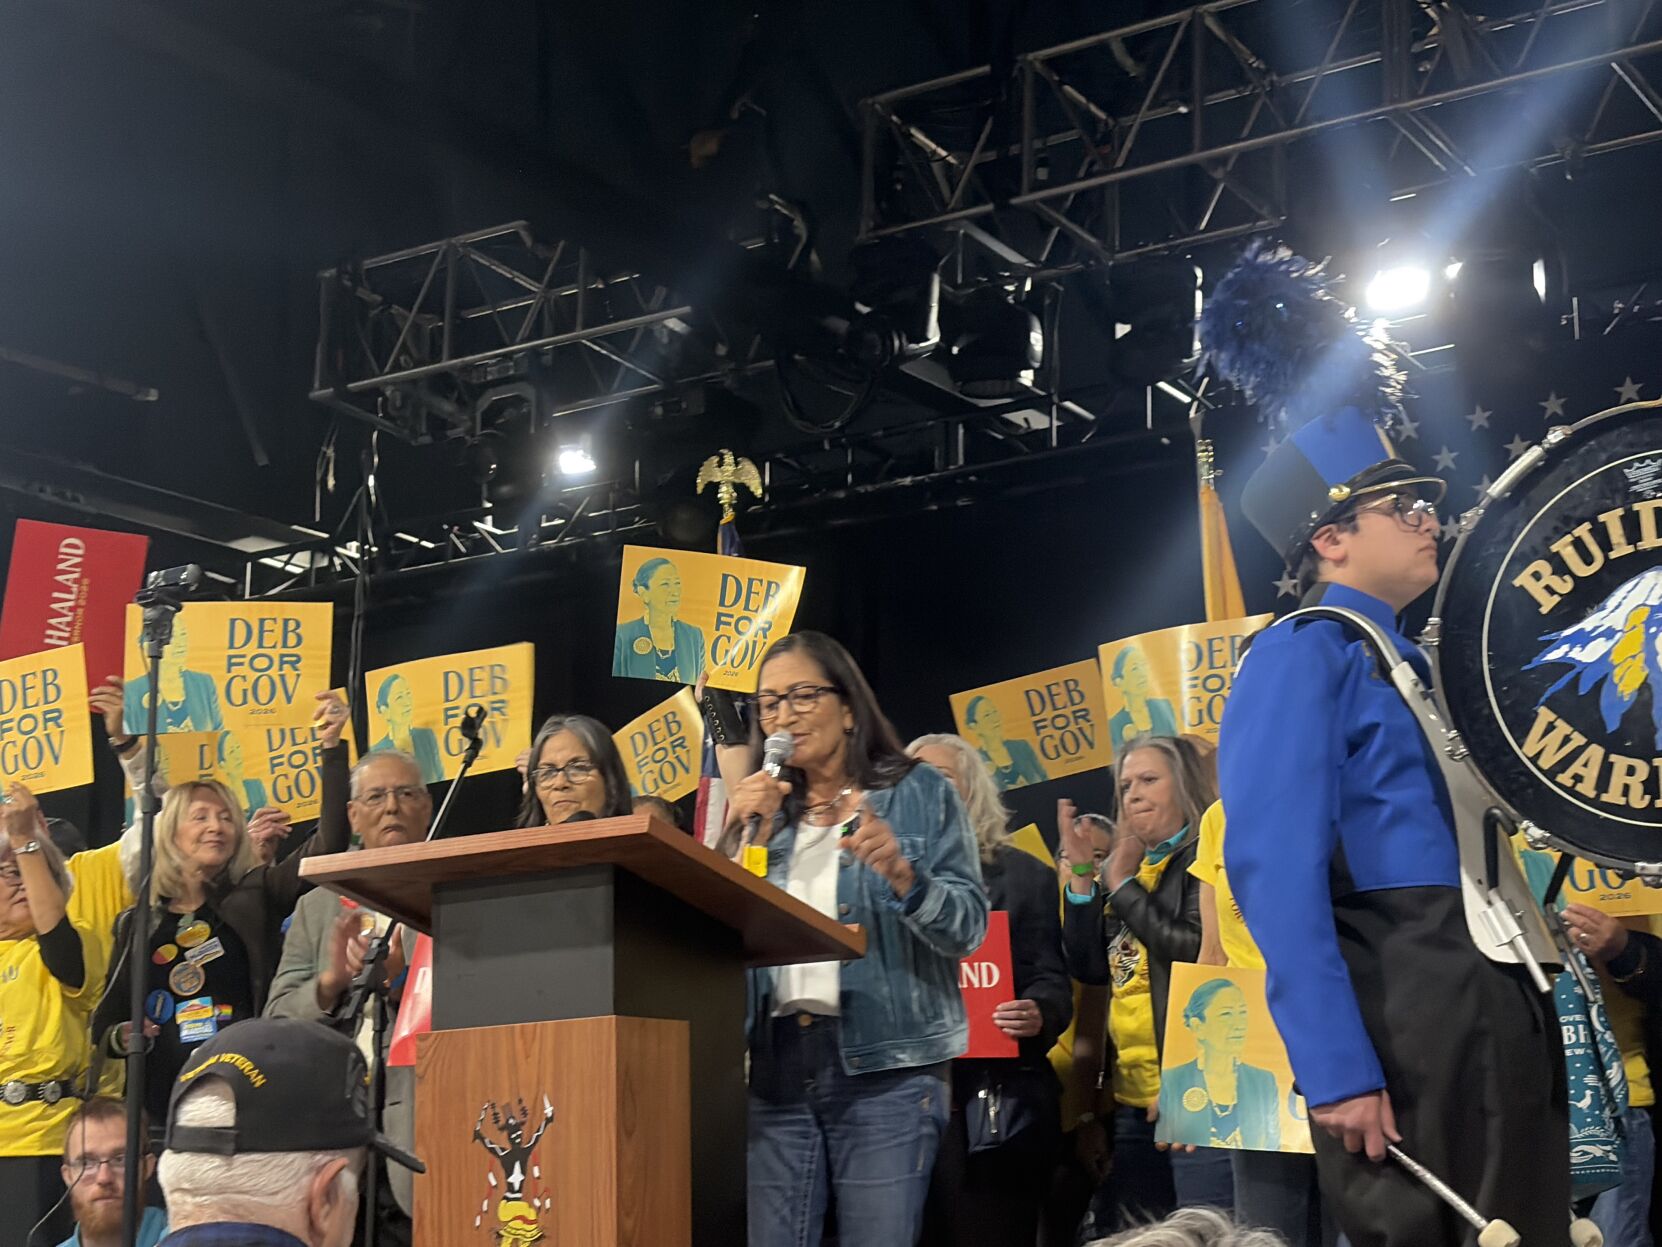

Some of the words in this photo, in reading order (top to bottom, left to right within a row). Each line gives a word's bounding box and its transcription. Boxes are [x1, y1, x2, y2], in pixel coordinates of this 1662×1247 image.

[43, 537, 86, 646] HAALAND
[718, 573, 780, 613] DEB
[228, 617, 304, 650] DEB
[715, 612, 773, 639] FOR
[226, 653, 303, 674] FOR
[711, 634, 767, 670] GOV
[0, 668, 62, 715] DEB
[225, 673, 301, 707] GOV
[443, 664, 509, 703] DEB
[1024, 679, 1085, 717] DEB
[0, 708, 64, 740] FOR
[1033, 708, 1092, 736] FOR
[1185, 694, 1227, 727] GO
[1, 730, 64, 775] GOV
[630, 711, 682, 758] DEB
[1040, 724, 1094, 760] GOV
[637, 736, 688, 774] FOR
[642, 750, 690, 794] GOV
[1521, 705, 1662, 809] WAR
[272, 766, 322, 803] GO
[1600, 893, 1632, 901] 2026
[219, 1053, 267, 1088] VETERAN
